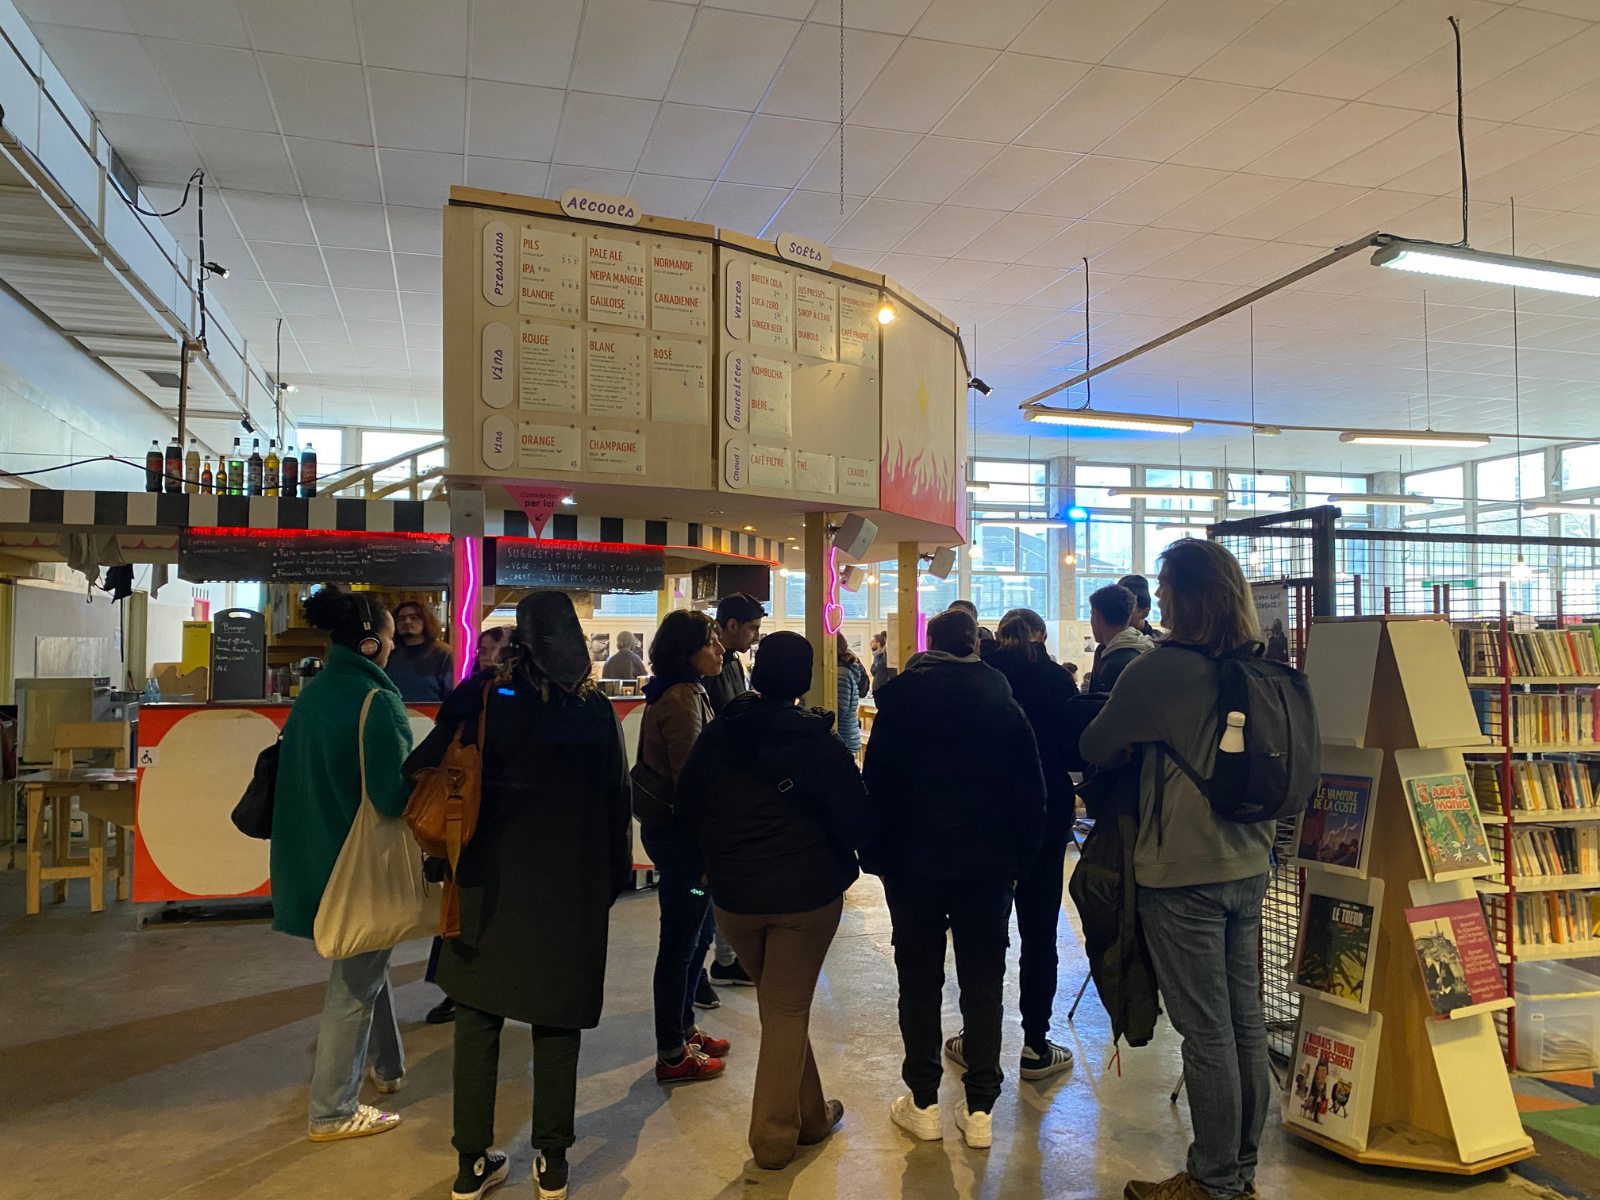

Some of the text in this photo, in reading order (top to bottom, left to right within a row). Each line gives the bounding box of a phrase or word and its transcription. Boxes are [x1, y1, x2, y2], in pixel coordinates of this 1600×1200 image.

[567, 196, 634, 218] Alcools
[522, 238, 540, 250] PILS
[590, 248, 622, 261] PALE ALE
[788, 242, 822, 262] Softs
[494, 232, 504, 296] Pressions
[522, 263, 535, 274] IPA
[654, 257, 693, 271] NORMANDE
[590, 270, 612, 282] NEIPA
[613, 272, 643, 287] MANGUE
[751, 273, 782, 289] BREIZH COLA
[522, 288, 554, 300] BLANCHE
[654, 293, 699, 308] CANADIENNE
[590, 295, 625, 309] GAULOISE
[752, 297, 779, 311] COCA ZERO
[752, 319, 782, 333] GINGER BEER
[522, 333, 550, 345] ROUGE
[590, 341, 615, 353] BLANC
[654, 348, 672, 360] ROSÉ
[492, 349, 503, 380] Vins
[751, 365, 783, 380] KOMBUCHA
[751, 398, 767, 410] BIÈRE
[494, 431, 502, 454] Vins
[521, 435, 555, 446] ORANGE
[589, 440, 636, 452] CHAMPAGNE
[751, 454, 784, 468] CAFÉ FILTRE
[797, 460, 807, 471] THÉ
[848, 467, 864, 478] CHAUD
[183, 527, 211, 536] Menu
[215, 528, 228, 536] de
[248, 529, 296, 538] semaine
[535, 541, 584, 551] Sandwich
[602, 545, 630, 554] snack
[222, 622, 246, 632] Burger
[1316, 784, 1359, 802] LE VAMPIRE
[1313, 799, 1358, 814] DE LA COSTE
[1332, 907, 1341, 921] LE
[1342, 909, 1364, 927] TUEUR
